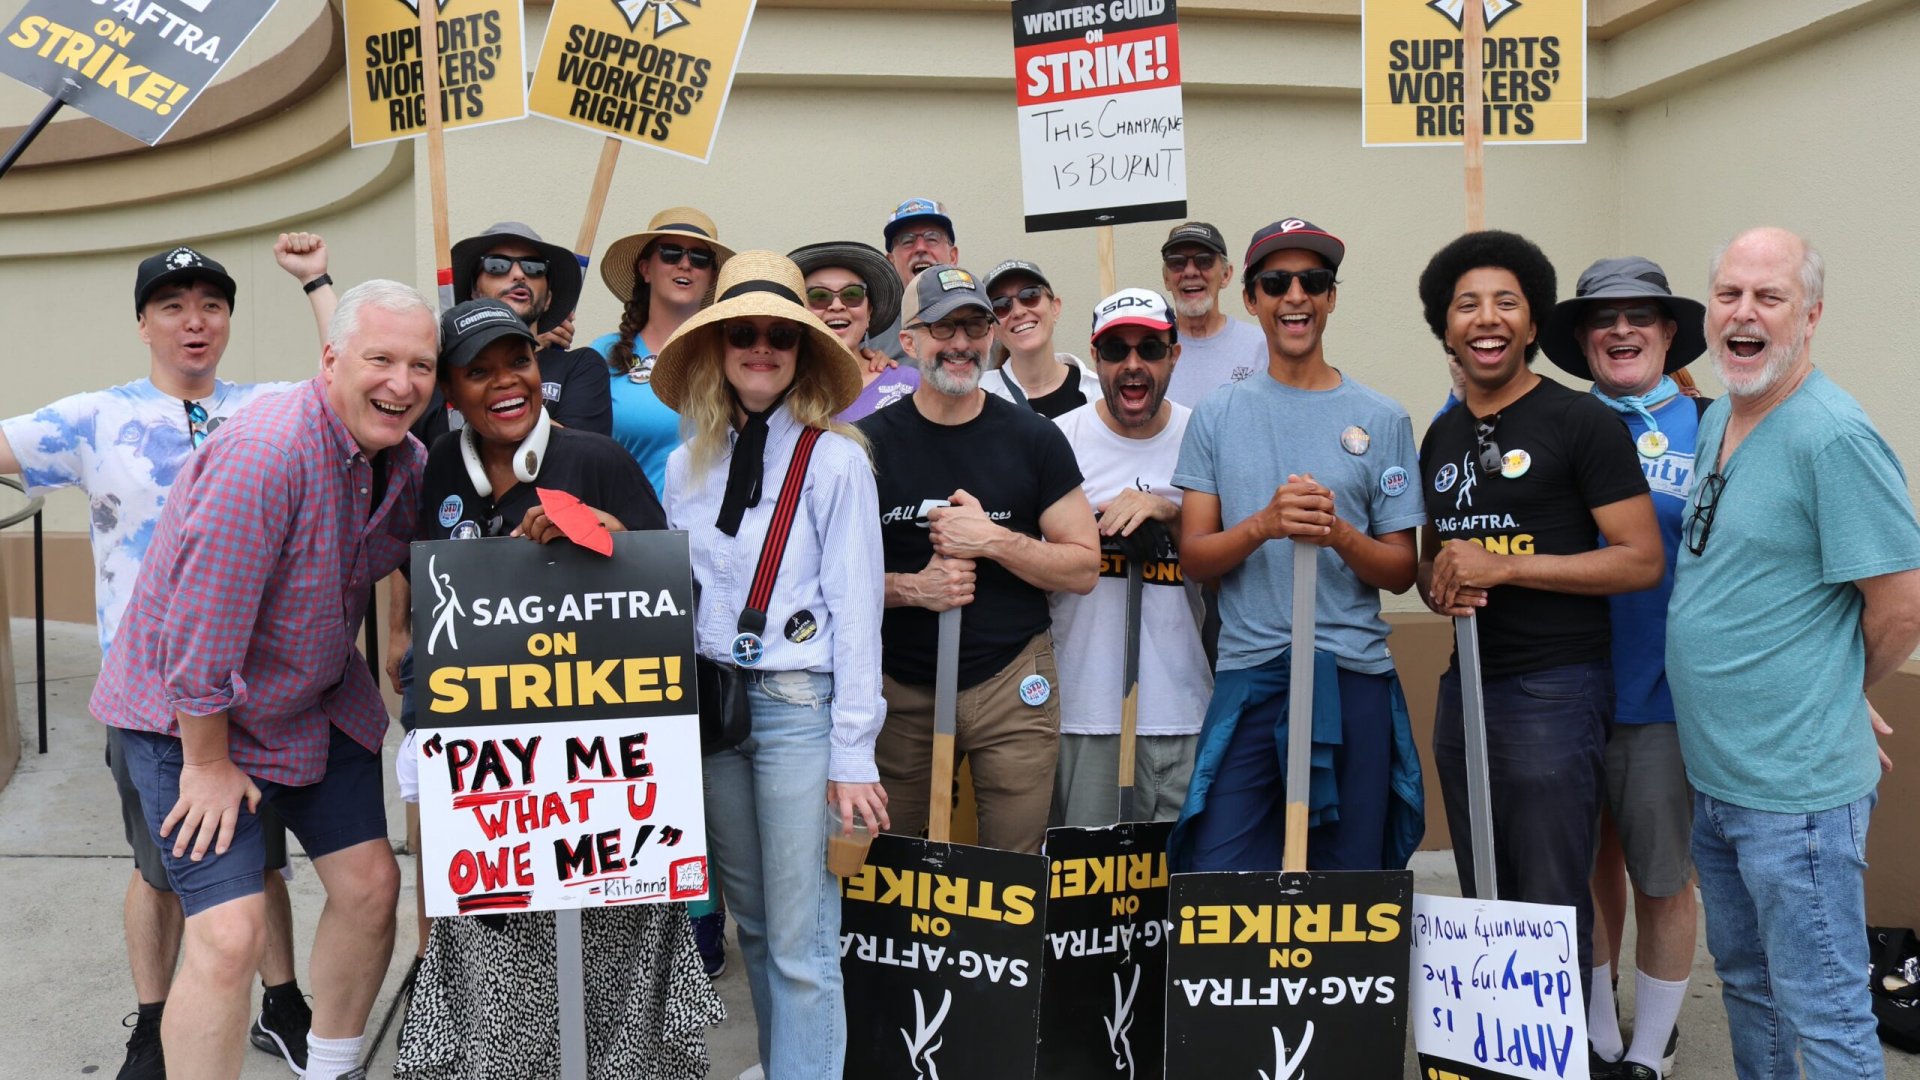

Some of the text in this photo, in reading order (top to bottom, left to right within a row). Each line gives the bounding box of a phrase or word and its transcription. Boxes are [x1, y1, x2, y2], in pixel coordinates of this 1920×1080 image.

[94, 19, 135, 48] ON
[1023, 0, 1165, 35] WRITERS GUILD
[1085, 29, 1103, 44] ON
[8, 15, 189, 116] STRIKE!
[366, 45, 501, 102] WORERS'
[565, 24, 711, 88] SUPPORTS
[1026, 36, 1169, 97] STRIKE!
[557, 52, 703, 115] WORKERS'
[1388, 70, 1559, 104] WORERS'
[569, 88, 672, 141] RIGHTS
[1032, 99, 1183, 142] THIS CHAMPAGNE
[1053, 162, 1080, 189] IS
[882, 506, 915, 524] All
[527, 631, 577, 657] ON
[428, 656, 684, 714] STRIKE!
[566, 732, 654, 782] ME
[472, 782, 657, 841] WHAT U
[448, 842, 534, 895] OWE
[1050, 852, 1168, 899] TRIKE!
[911, 913, 951, 937] ON
[1112, 895, 1139, 916] ON
[1179, 903, 1402, 944] STRIKE!
[1269, 947, 1313, 968] ON
[1475, 915, 1570, 964] Community
[1422, 963, 1463, 1000] the
[1433, 1006, 1573, 1079] AMPTP is
